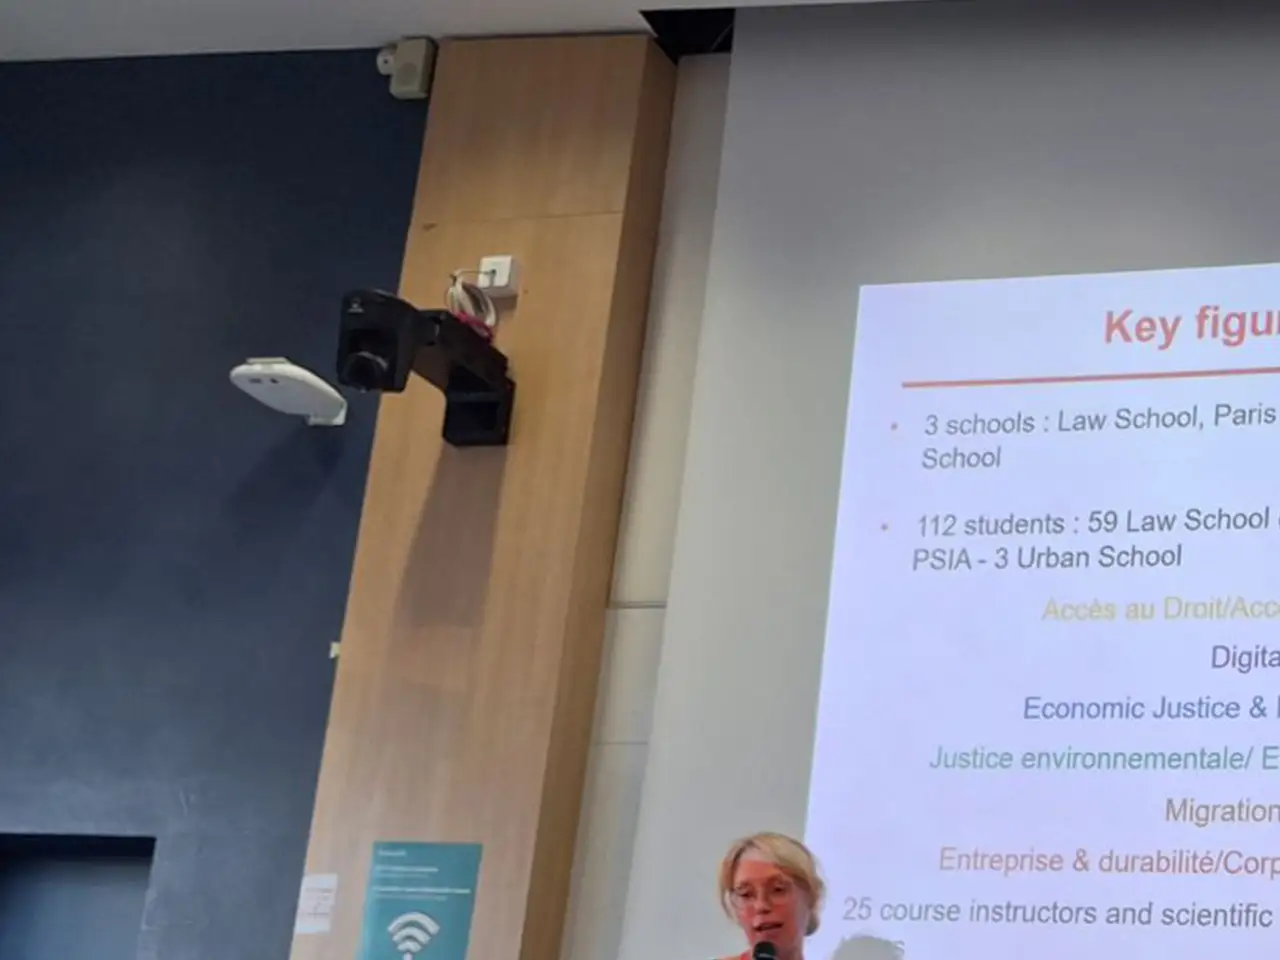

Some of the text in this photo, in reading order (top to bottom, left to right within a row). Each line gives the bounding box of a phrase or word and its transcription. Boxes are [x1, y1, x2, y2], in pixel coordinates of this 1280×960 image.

[1104, 309, 1182, 351] Key
[924, 413, 939, 436] 3
[945, 411, 1036, 436] schools
[1057, 409, 1108, 432] Law
[1114, 404, 1204, 431] School,
[1214, 402, 1277, 427] Paris
[921, 445, 1002, 470] School
[919, 513, 957, 538] 112
[964, 513, 1066, 536] students
[1087, 509, 1119, 534] 59
[1126, 509, 1177, 533] Law
[1183, 505, 1270, 532] School
[912, 547, 973, 571] PSIA
[993, 546, 1009, 570] 3
[1017, 545, 1090, 570] Urban
[1097, 543, 1183, 569] School
[1041, 598, 1119, 623] Accès
[1124, 601, 1157, 622] au
[1023, 695, 1146, 720] Economic
[1152, 695, 1241, 720] Justice
[1248, 695, 1268, 719] &
[929, 745, 1014, 770] Justice
[1020, 745, 1254, 771] environnementale/
[938, 846, 1065, 878] Entreprise
[1072, 847, 1090, 873] &
[842, 896, 873, 921] 25
[879, 903, 962, 922] course
[969, 900, 1097, 925] instructors
[1105, 901, 1154, 926] and
[1160, 901, 1273, 928] scientific
